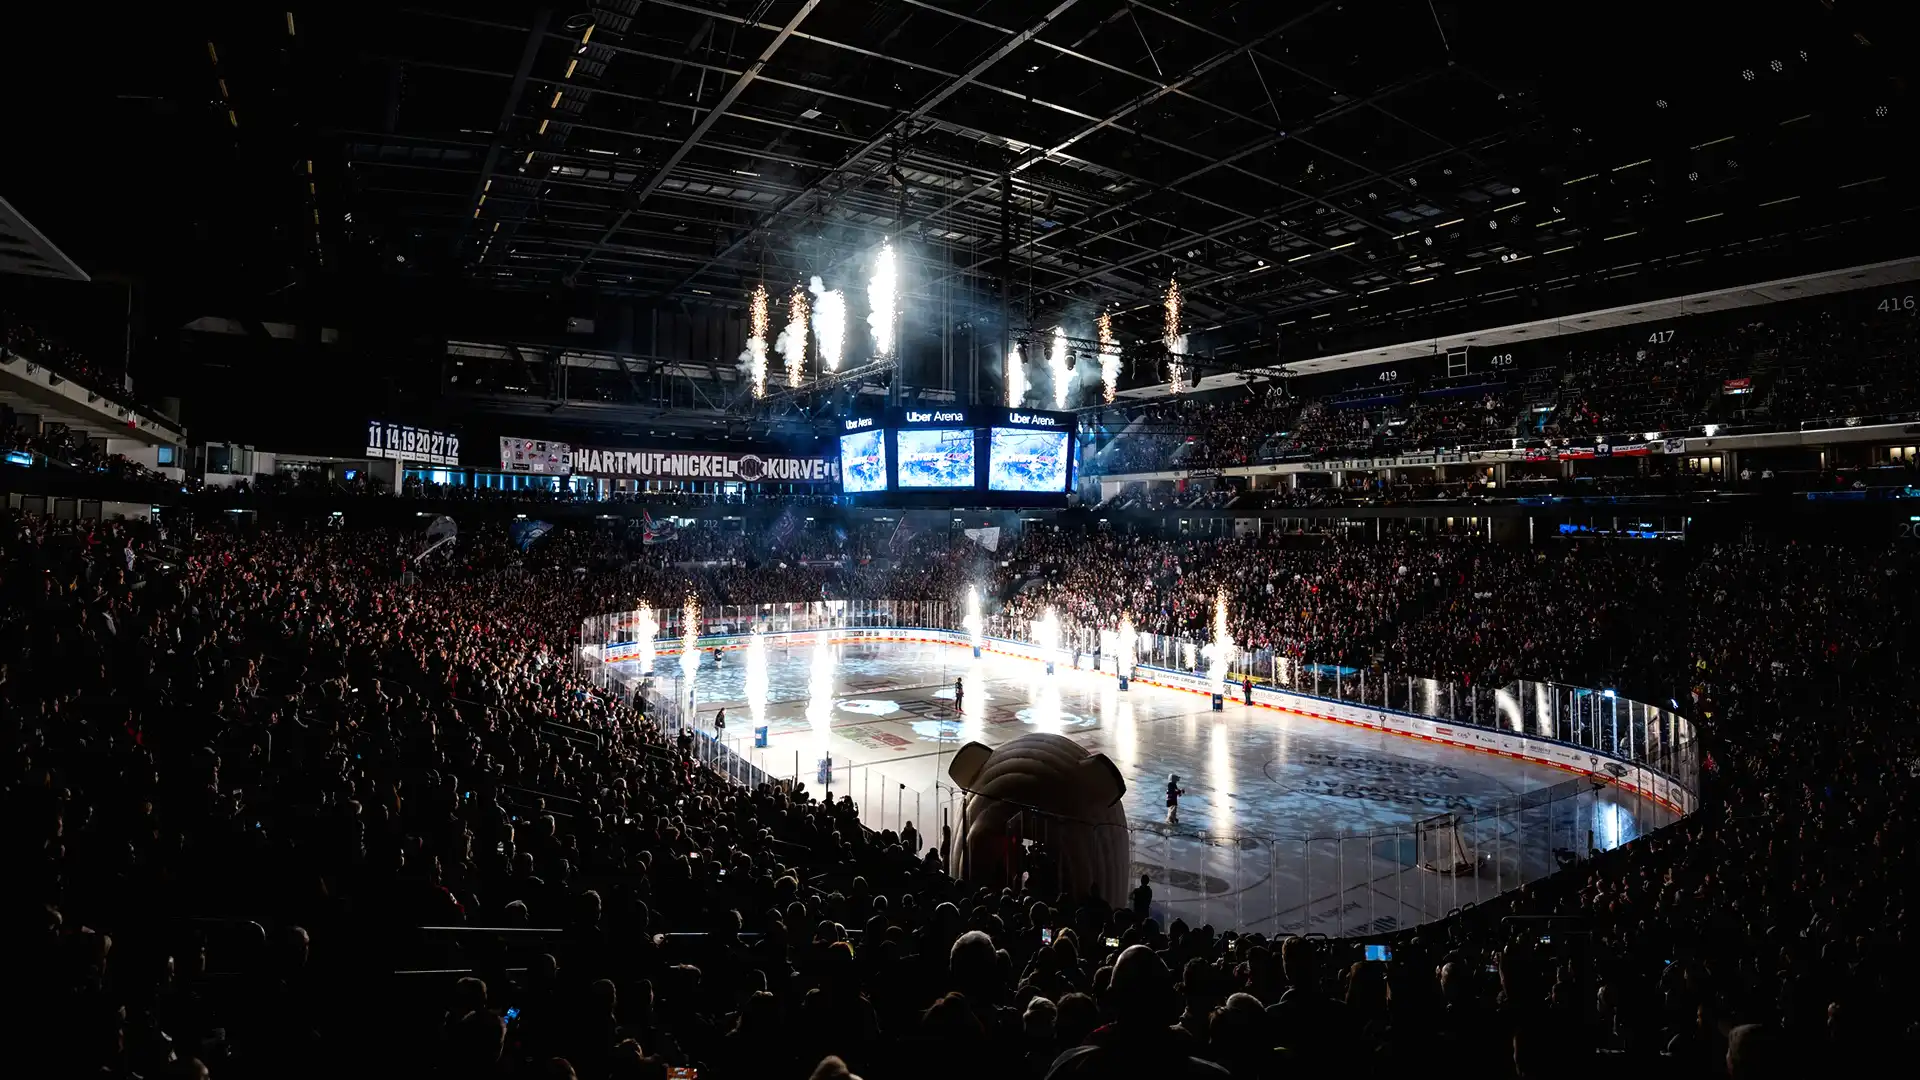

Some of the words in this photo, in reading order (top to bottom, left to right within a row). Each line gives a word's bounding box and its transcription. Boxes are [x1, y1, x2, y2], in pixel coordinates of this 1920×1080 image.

[1877, 295, 1915, 313] 416
[1648, 329, 1675, 344] 417
[1490, 353, 1513, 366] 418
[1378, 370, 1397, 382] 419
[845, 419, 858, 430] Uber
[858, 417, 873, 428] Arena
[906, 411, 932, 423] Uber
[934, 410, 963, 422] Arena
[1009, 412, 1031, 424] Uber
[1031, 413, 1055, 426] Arena
[368, 425, 382, 448] 11
[386, 427, 399, 449] 14
[401, 430, 415, 452] 19
[416, 432, 430, 454] 20
[431, 434, 445, 455] 27
[446, 436, 459, 457] 72
[578, 448, 665, 475] HARTMUT
[671, 454, 733, 478] NICKEL
[767, 458, 824, 480] KURVE
[327, 515, 345, 527] 24
